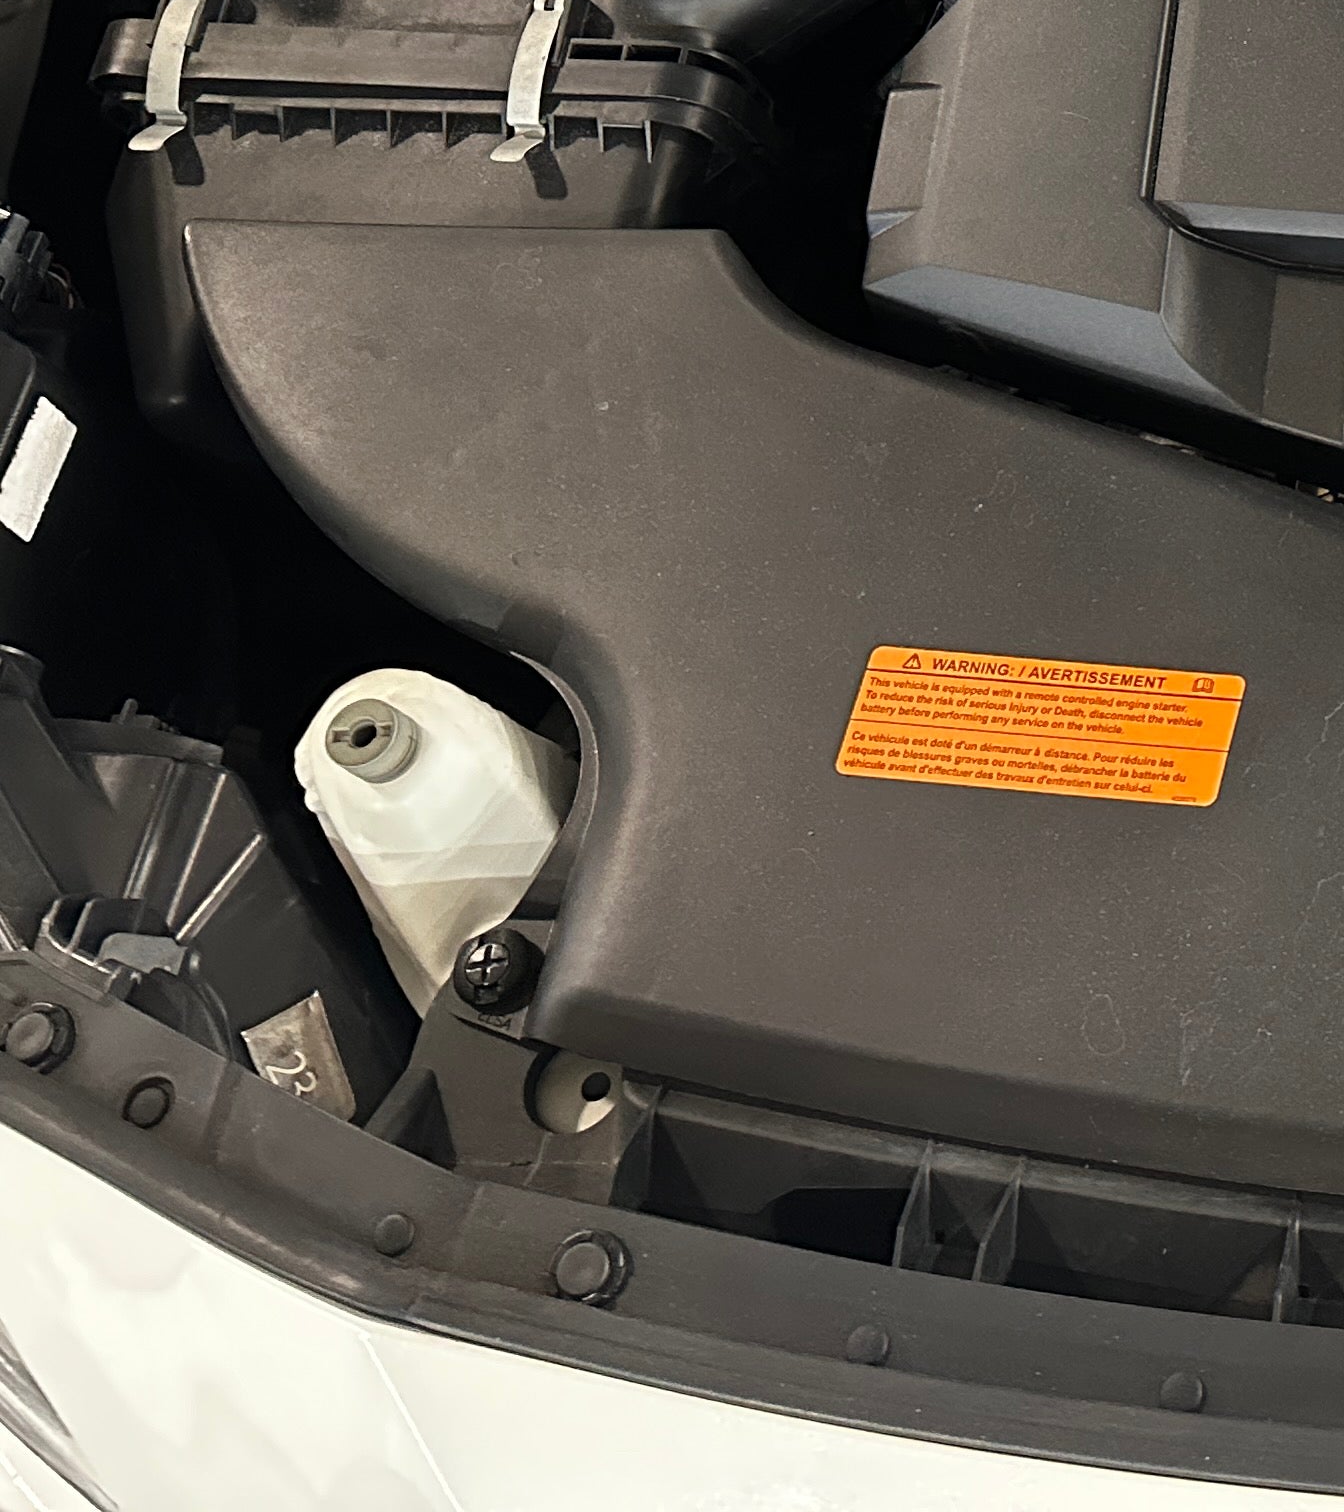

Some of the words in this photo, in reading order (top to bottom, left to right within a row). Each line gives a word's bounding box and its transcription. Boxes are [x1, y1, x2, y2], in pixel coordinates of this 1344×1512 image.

[933, 658, 1015, 676] WARNING:
[1028, 666, 1167, 690] AVERTISSEMENT
[866, 689, 878, 700] To
[879, 690, 914, 703] reduce
[916, 693, 932, 705] the
[934, 695, 954, 707] risk
[957, 698, 968, 708] of
[969, 699, 1007, 711] serious
[1041, 707, 1052, 715] or
[1054, 706, 1086, 719] Death,
[1089, 709, 1145, 723] disconnect
[1148, 713, 1164, 725] the
[1167, 716, 1203, 727] vehicle
[870, 677, 891, 688] This
[893, 680, 929, 692] vehicle
[931, 682, 940, 692] is
[942, 683, 990, 698] equipped
[992, 686, 1013, 698] with
[1015, 691, 1021, 699] a
[1025, 692, 1060, 703] remote
[1062, 694, 1113, 707] controlled
[1116, 699, 1150, 711] engine
[1153, 701, 1188, 713] starter.
[860, 703, 896, 716] battery
[898, 705, 931, 718] before
[932, 707, 989, 725] performing
[990, 715, 1010, 726] any
[1012, 717, 1049, 729] service
[1051, 721, 1065, 729] on
[1067, 720, 1083, 731] the
[847, 745, 885, 759] risques
[887, 746, 901, 758] de
[903, 748, 952, 763] blessures
[954, 755, 990, 767] graves
[991, 758, 1006, 768] ou
[1007, 759, 1058, 773] mortelles,
[1060, 763, 1117, 778] débrancher
[1119, 767, 1129, 778] la
[1131, 768, 1171, 783] batterie
[1172, 772, 1187, 783] du
[852, 730, 866, 741] Ce
[868, 732, 910, 745] véhicule
[911, 736, 928, 747] est
[930, 737, 953, 749] doté
[955, 739, 978, 751] d'un
[980, 741, 1032, 756] démarreur
[1033, 746, 1041, 757] à
[1044, 749, 1090, 762] distance.
[1093, 751, 1118, 764] Pour
[1120, 754, 1157, 767] réduire
[1159, 757, 1175, 768] les
[843, 757, 887, 770] véhicule
[888, 763, 917, 774] avant
[918, 763, 974, 778] d'effectuer
[974, 768, 994, 780] des
[996, 772, 1034, 784] travaux
[1037, 774, 1092, 789] d'entretien
[1093, 781, 1112, 790] sur
